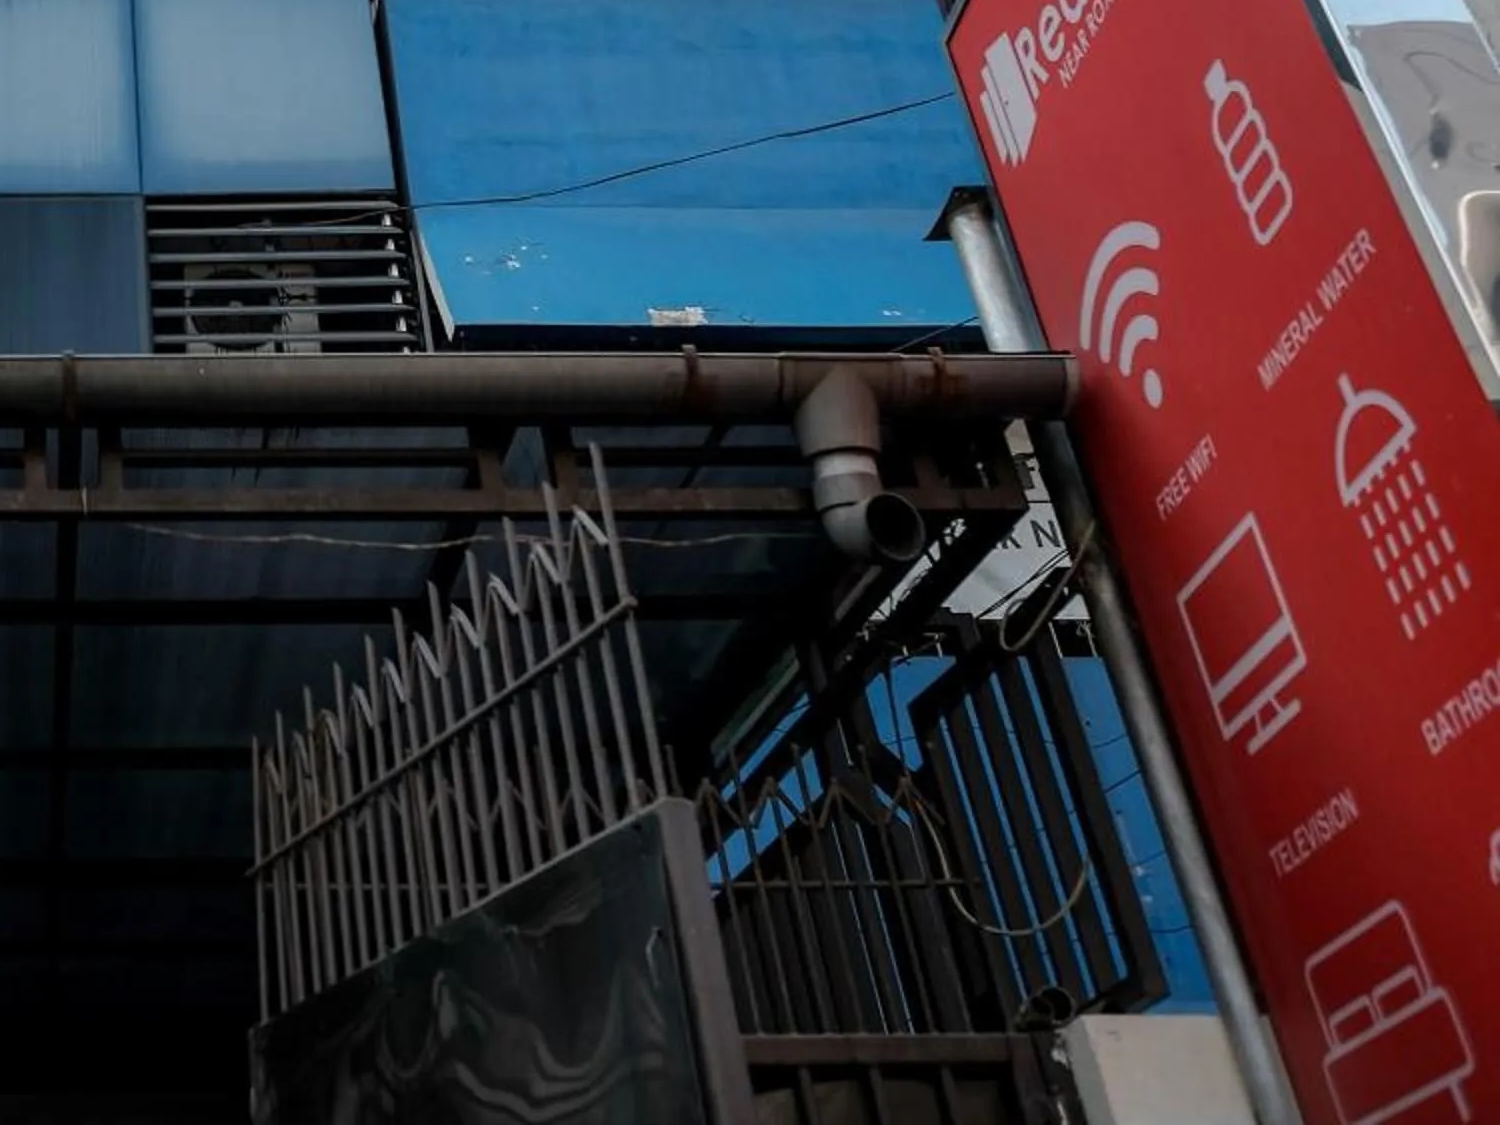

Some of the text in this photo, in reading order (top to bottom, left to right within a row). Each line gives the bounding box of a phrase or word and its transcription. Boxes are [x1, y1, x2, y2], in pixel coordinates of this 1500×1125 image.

[1058, 26, 1090, 89] NEAR
[1256, 227, 1377, 392] MINERAL WATER
[1155, 433, 1218, 522] FREE WIFI
[1268, 787, 1359, 878] TELEVISION
